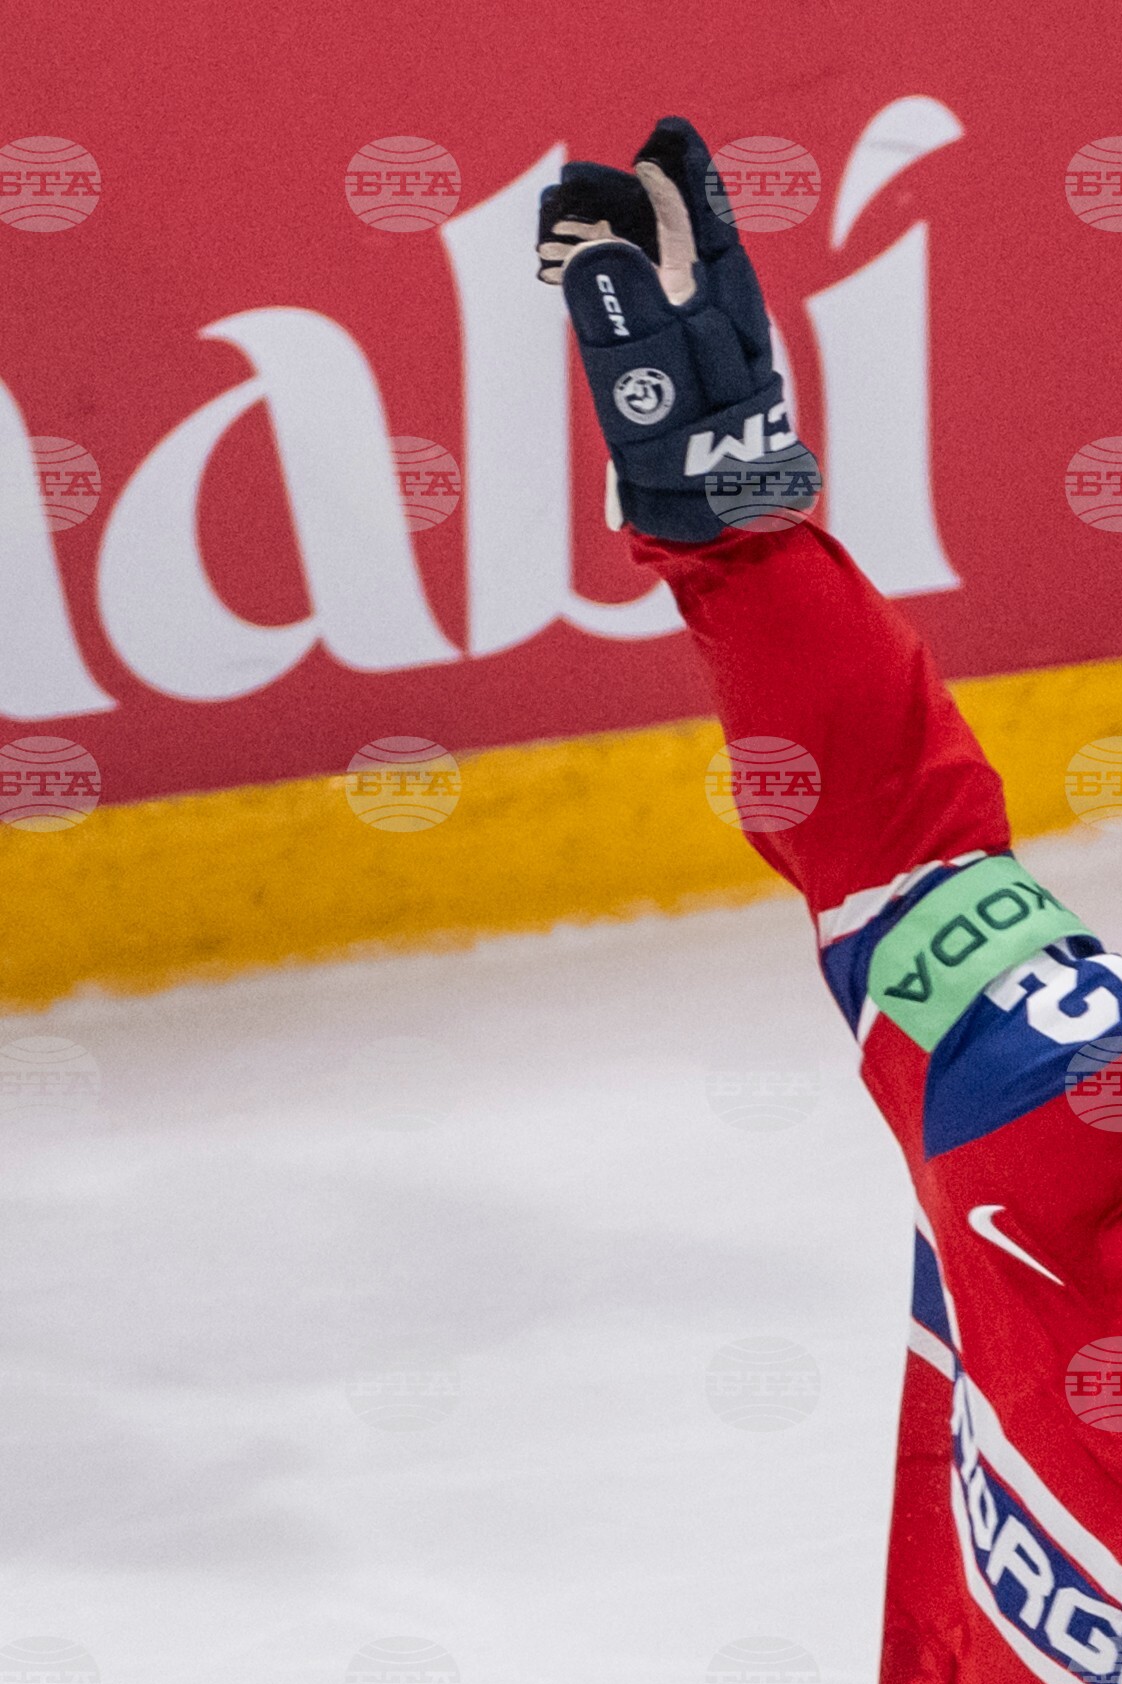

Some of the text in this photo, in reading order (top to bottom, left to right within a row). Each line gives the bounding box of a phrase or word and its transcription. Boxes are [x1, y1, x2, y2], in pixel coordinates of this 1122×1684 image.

[595, 273, 631, 337] CCM
[683, 402, 798, 477] CM
[884, 881, 1066, 1002] KODA
